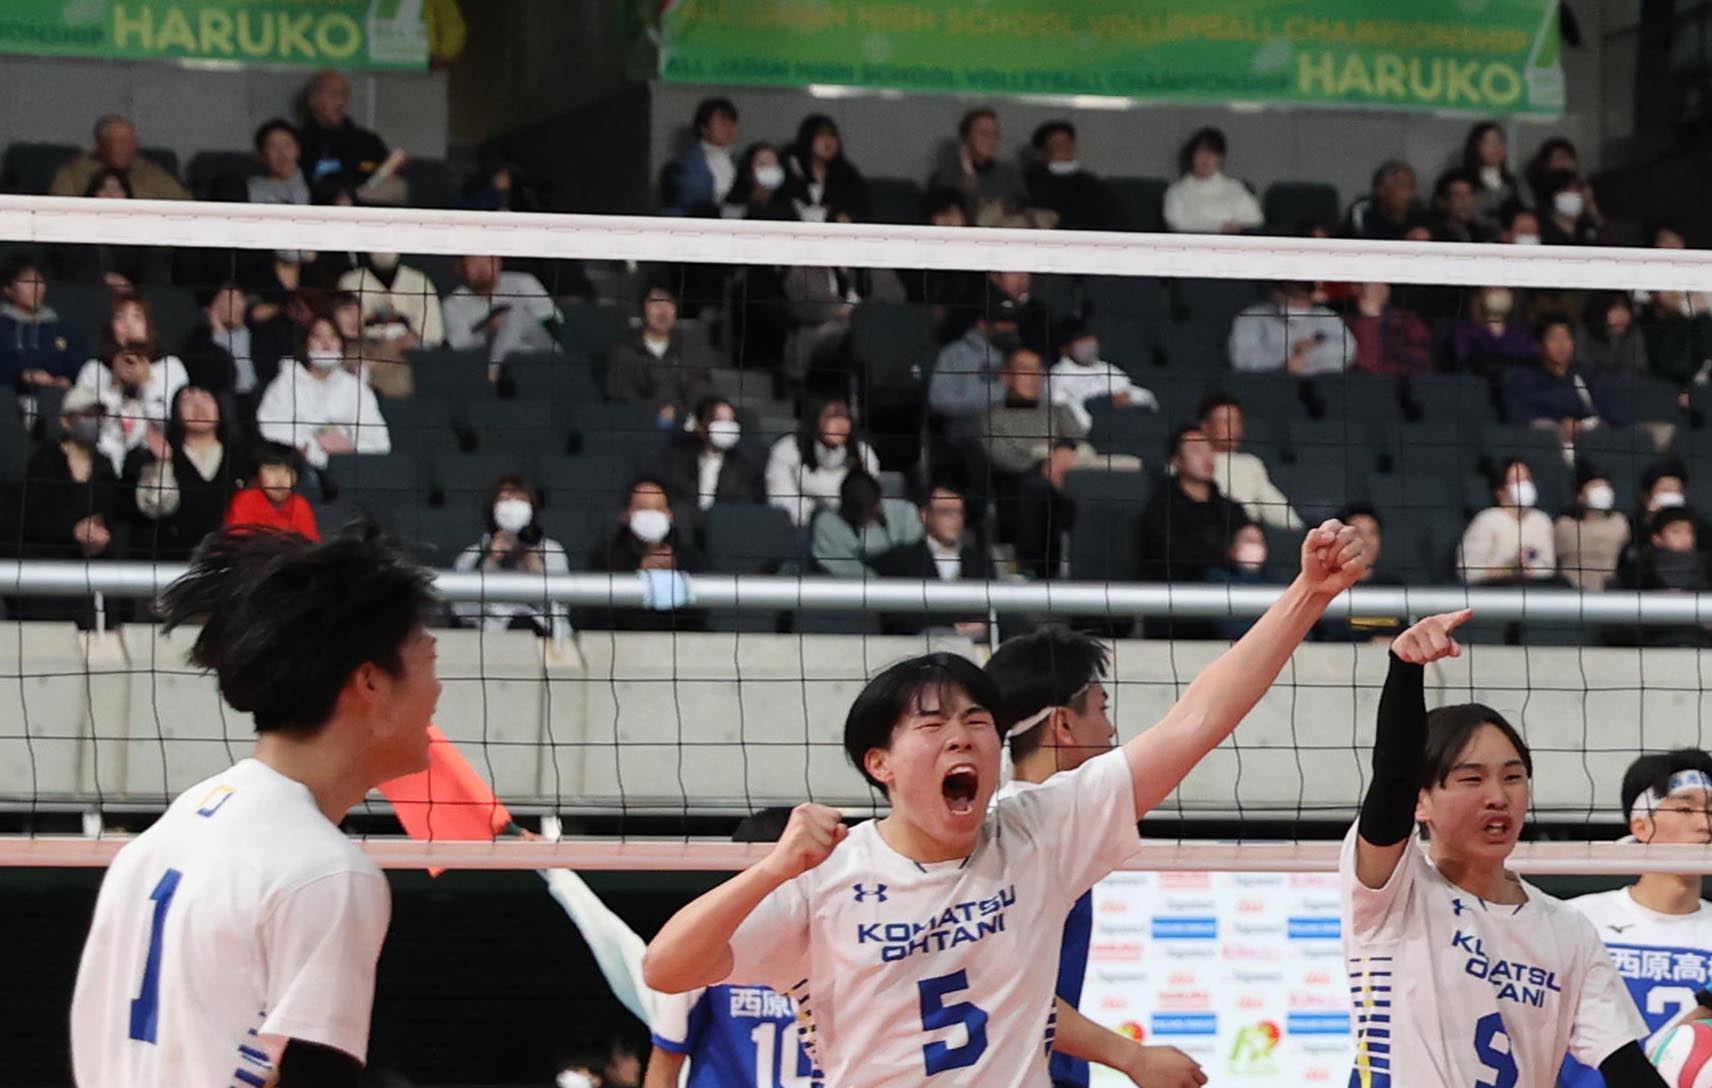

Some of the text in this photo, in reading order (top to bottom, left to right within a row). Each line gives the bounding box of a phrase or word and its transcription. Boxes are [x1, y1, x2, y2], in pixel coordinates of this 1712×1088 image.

[112, 5, 362, 58] HARUKO
[1299, 52, 1523, 102] HARUKO
[129, 868, 183, 1045] 1
[881, 912, 1006, 963] OHTANI
[729, 987, 798, 1019] 西原
[917, 968, 989, 1077] 5
